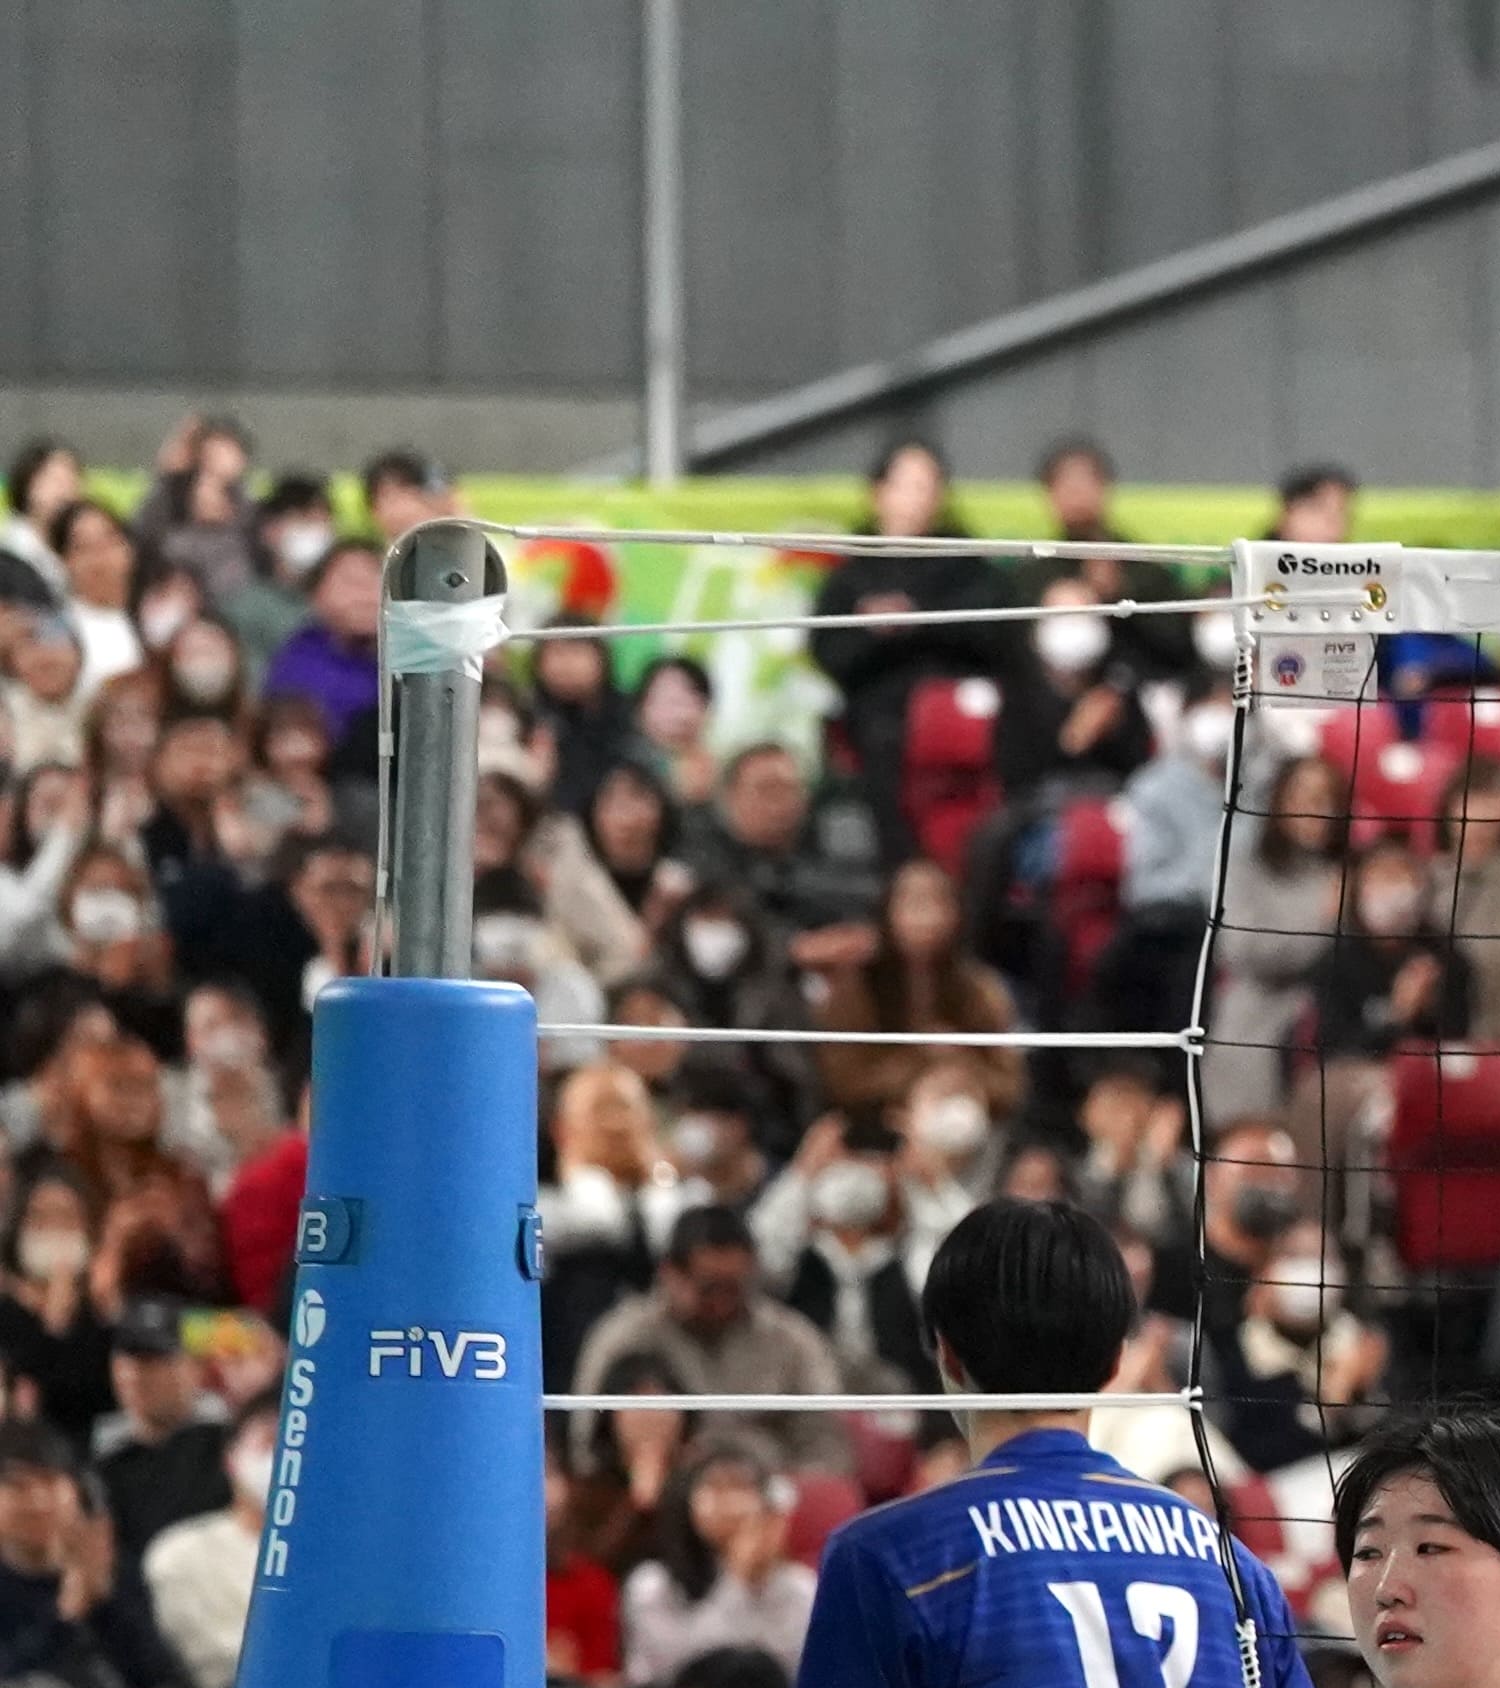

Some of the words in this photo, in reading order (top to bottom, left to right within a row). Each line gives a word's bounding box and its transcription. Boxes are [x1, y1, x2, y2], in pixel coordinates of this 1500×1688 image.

[1302, 558, 1381, 575] Senoh
[264, 1358, 316, 1577] Senoh
[968, 1498, 1222, 1567] KINRANKA
